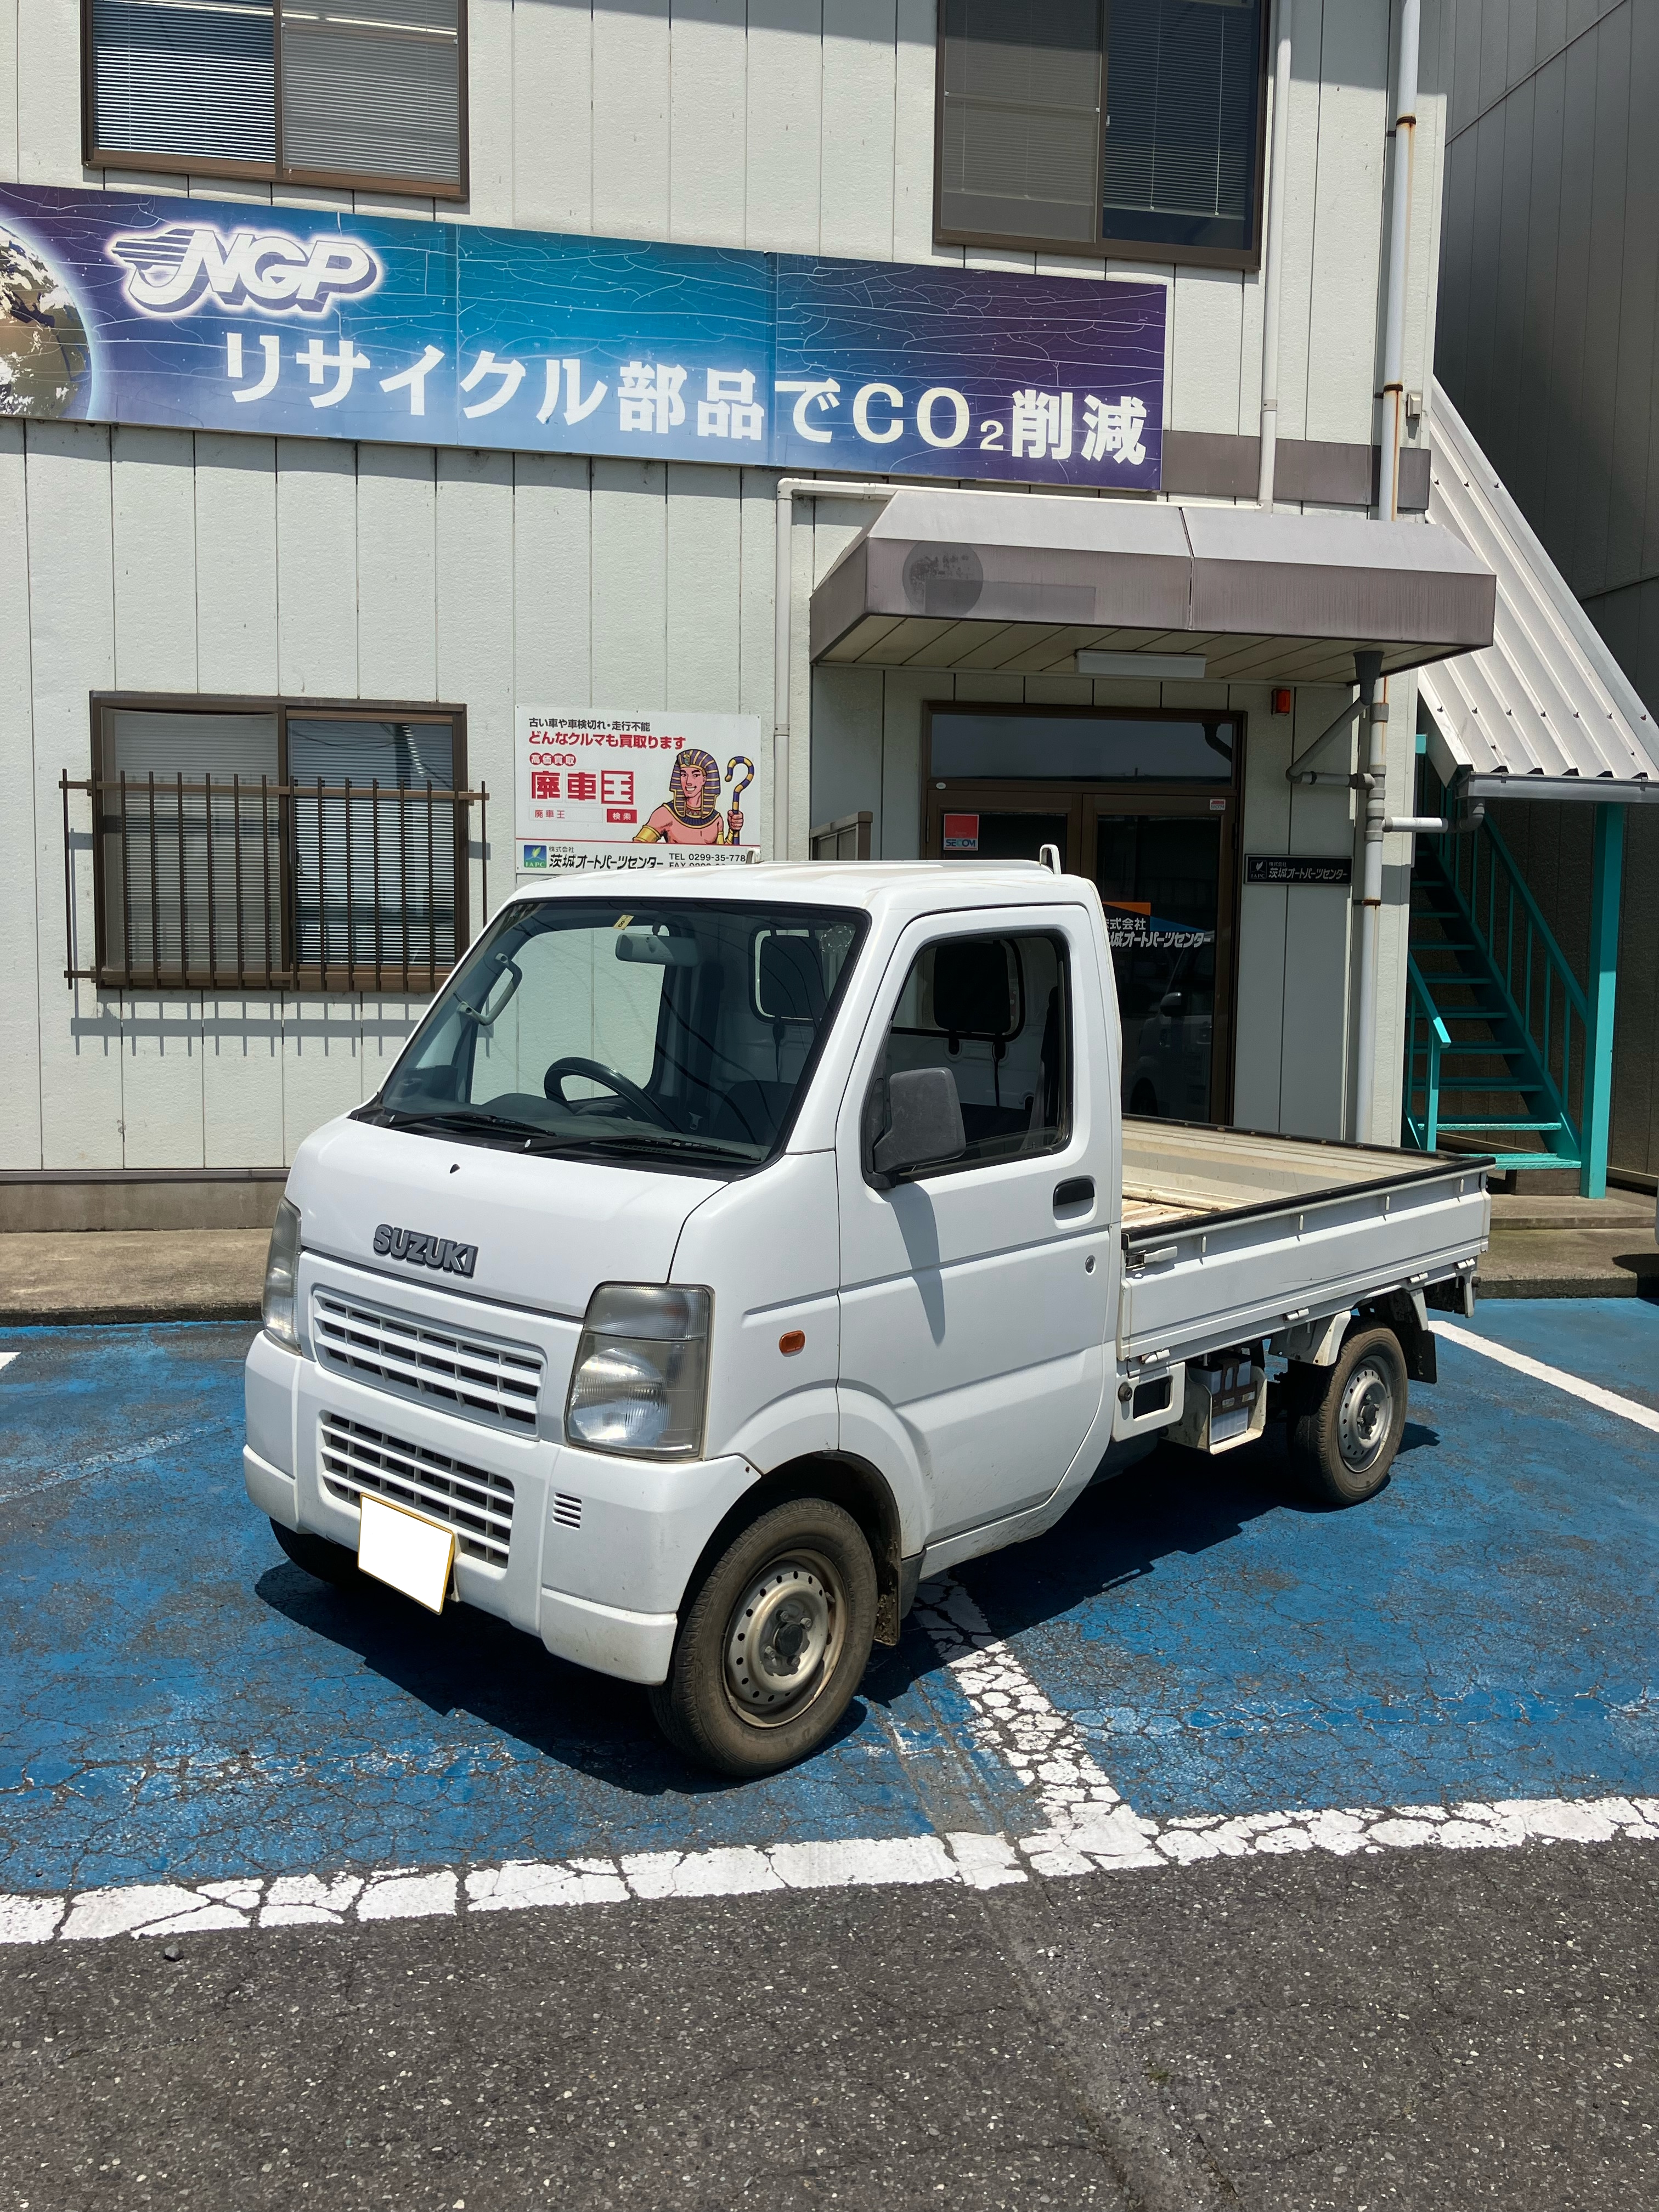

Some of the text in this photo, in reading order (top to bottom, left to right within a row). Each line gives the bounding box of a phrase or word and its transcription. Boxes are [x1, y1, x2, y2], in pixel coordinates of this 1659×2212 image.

[112, 228, 377, 313] NGP
[529, 718, 651, 732] 古い車や車検切れ・走行不能
[528, 731, 686, 750] どんなクルマも買取ります
[531, 770, 634, 805] 廃車王
[549, 854, 664, 870] 茨城オートパーツセンター
[689, 853, 746, 862] 0299-35-778
[1268, 867, 1348, 879] 茨城オートパーツセンター
[1108, 932, 1211, 948] 城オートパーツセンター
[373, 1223, 479, 1279] SUZUKI
